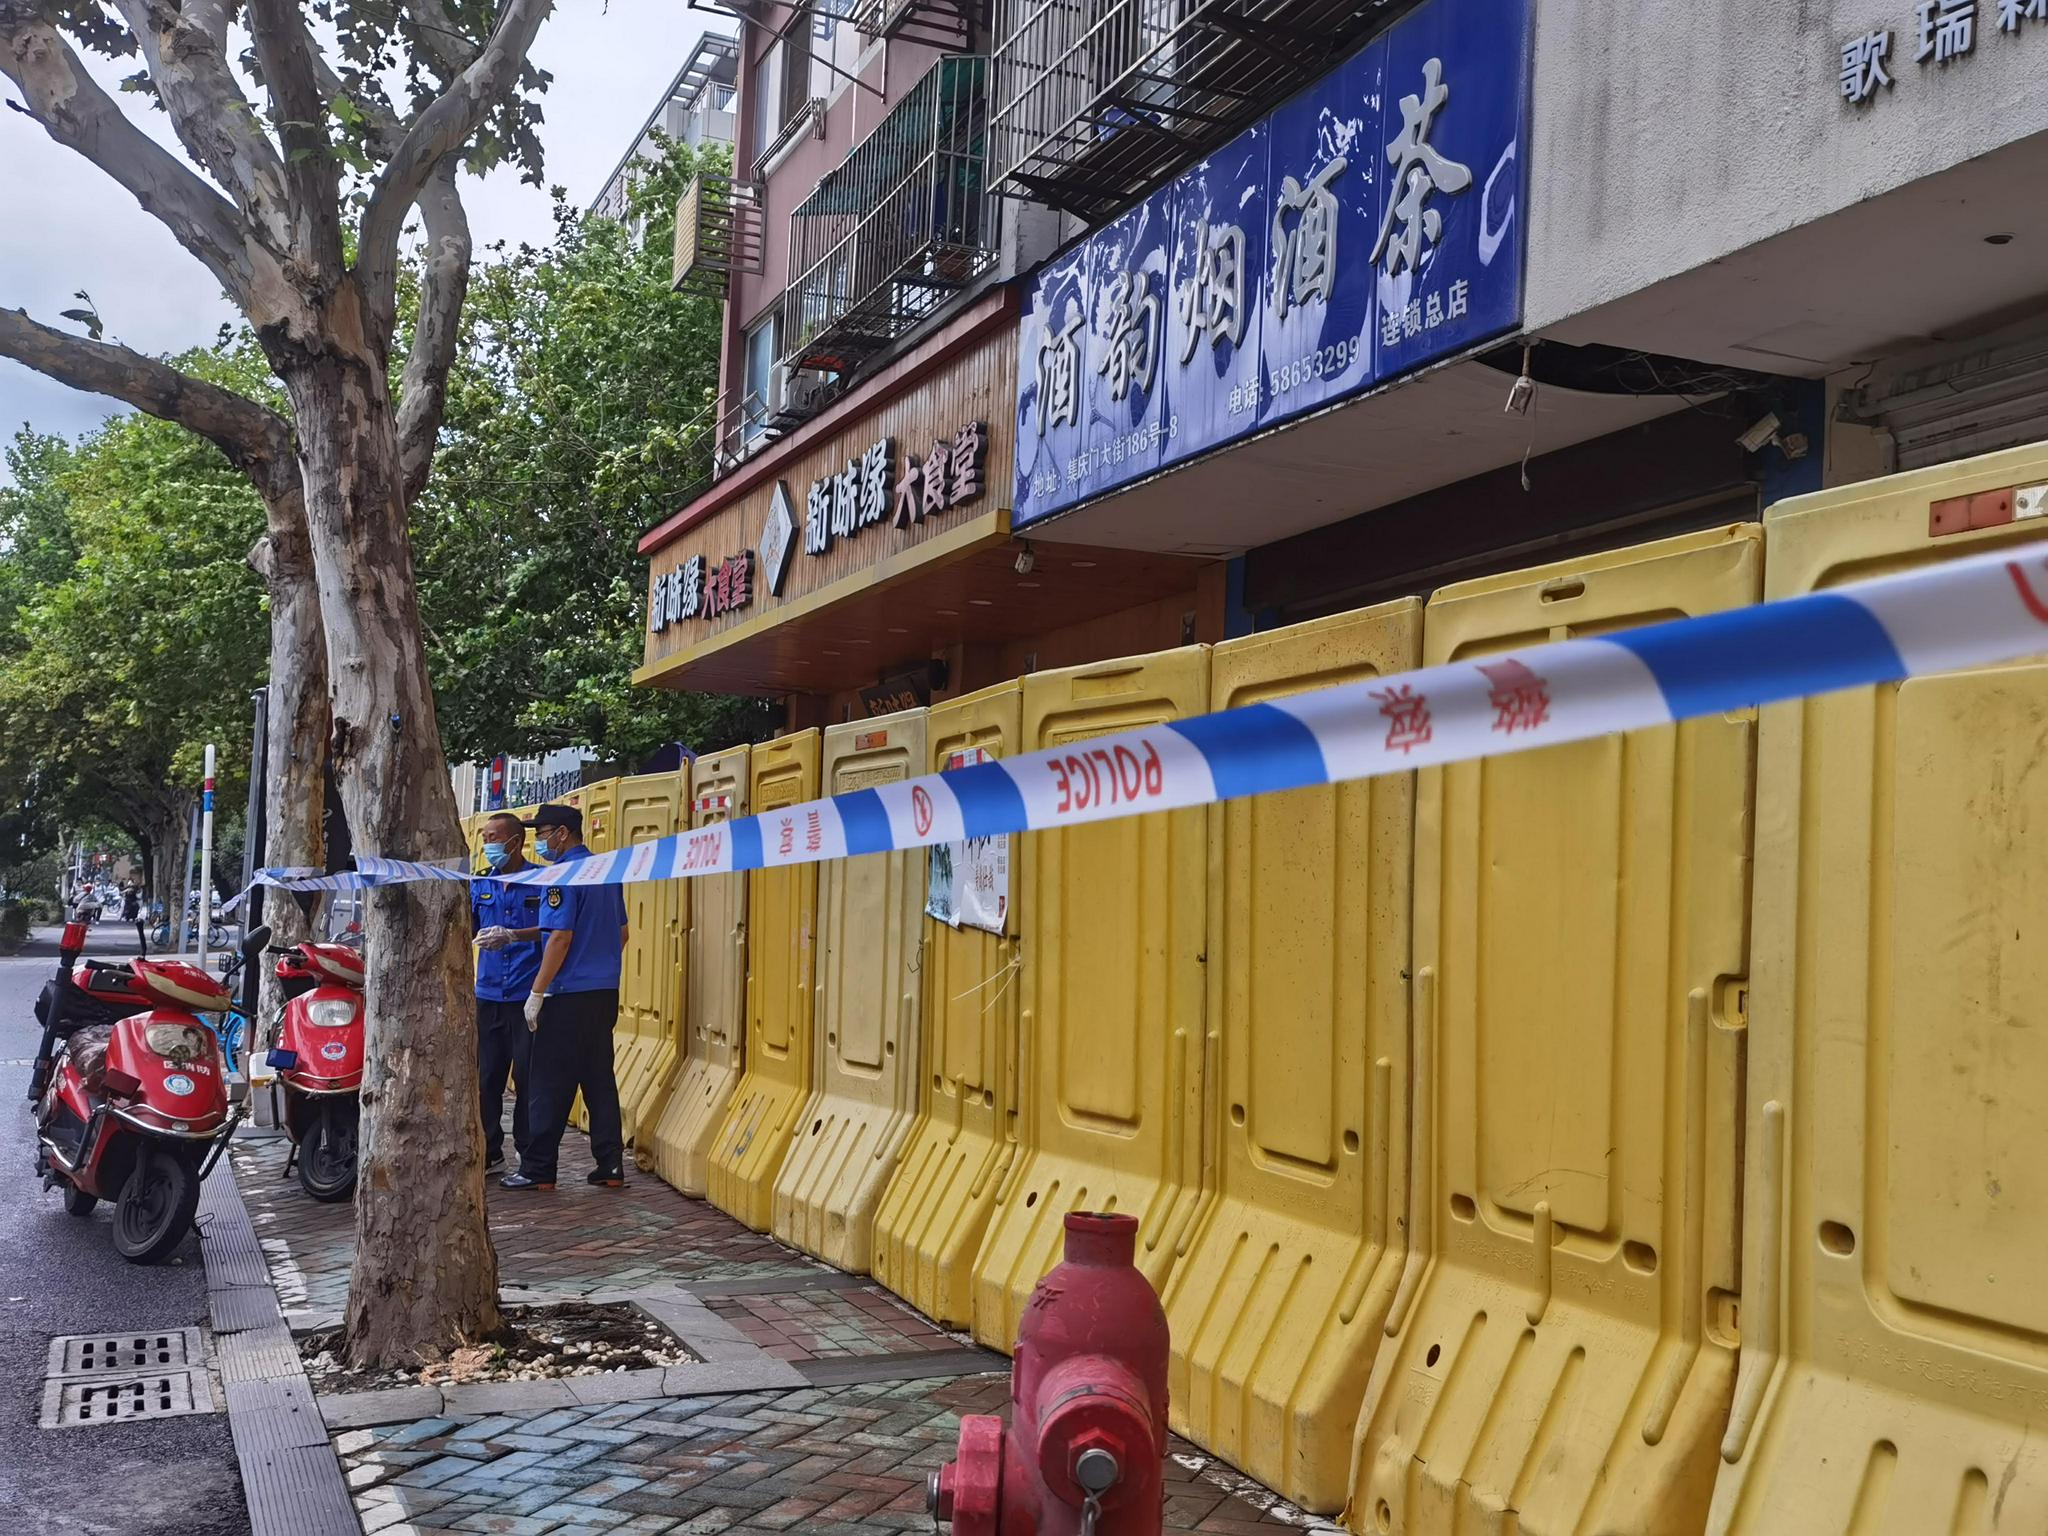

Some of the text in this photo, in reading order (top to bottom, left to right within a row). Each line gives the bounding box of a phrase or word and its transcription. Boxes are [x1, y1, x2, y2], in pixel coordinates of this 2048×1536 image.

[1380, 278, 1469, 347] 连锁总店
[1269, 335, 1361, 397] 58653299
[1046, 739, 1163, 814] POLICE
